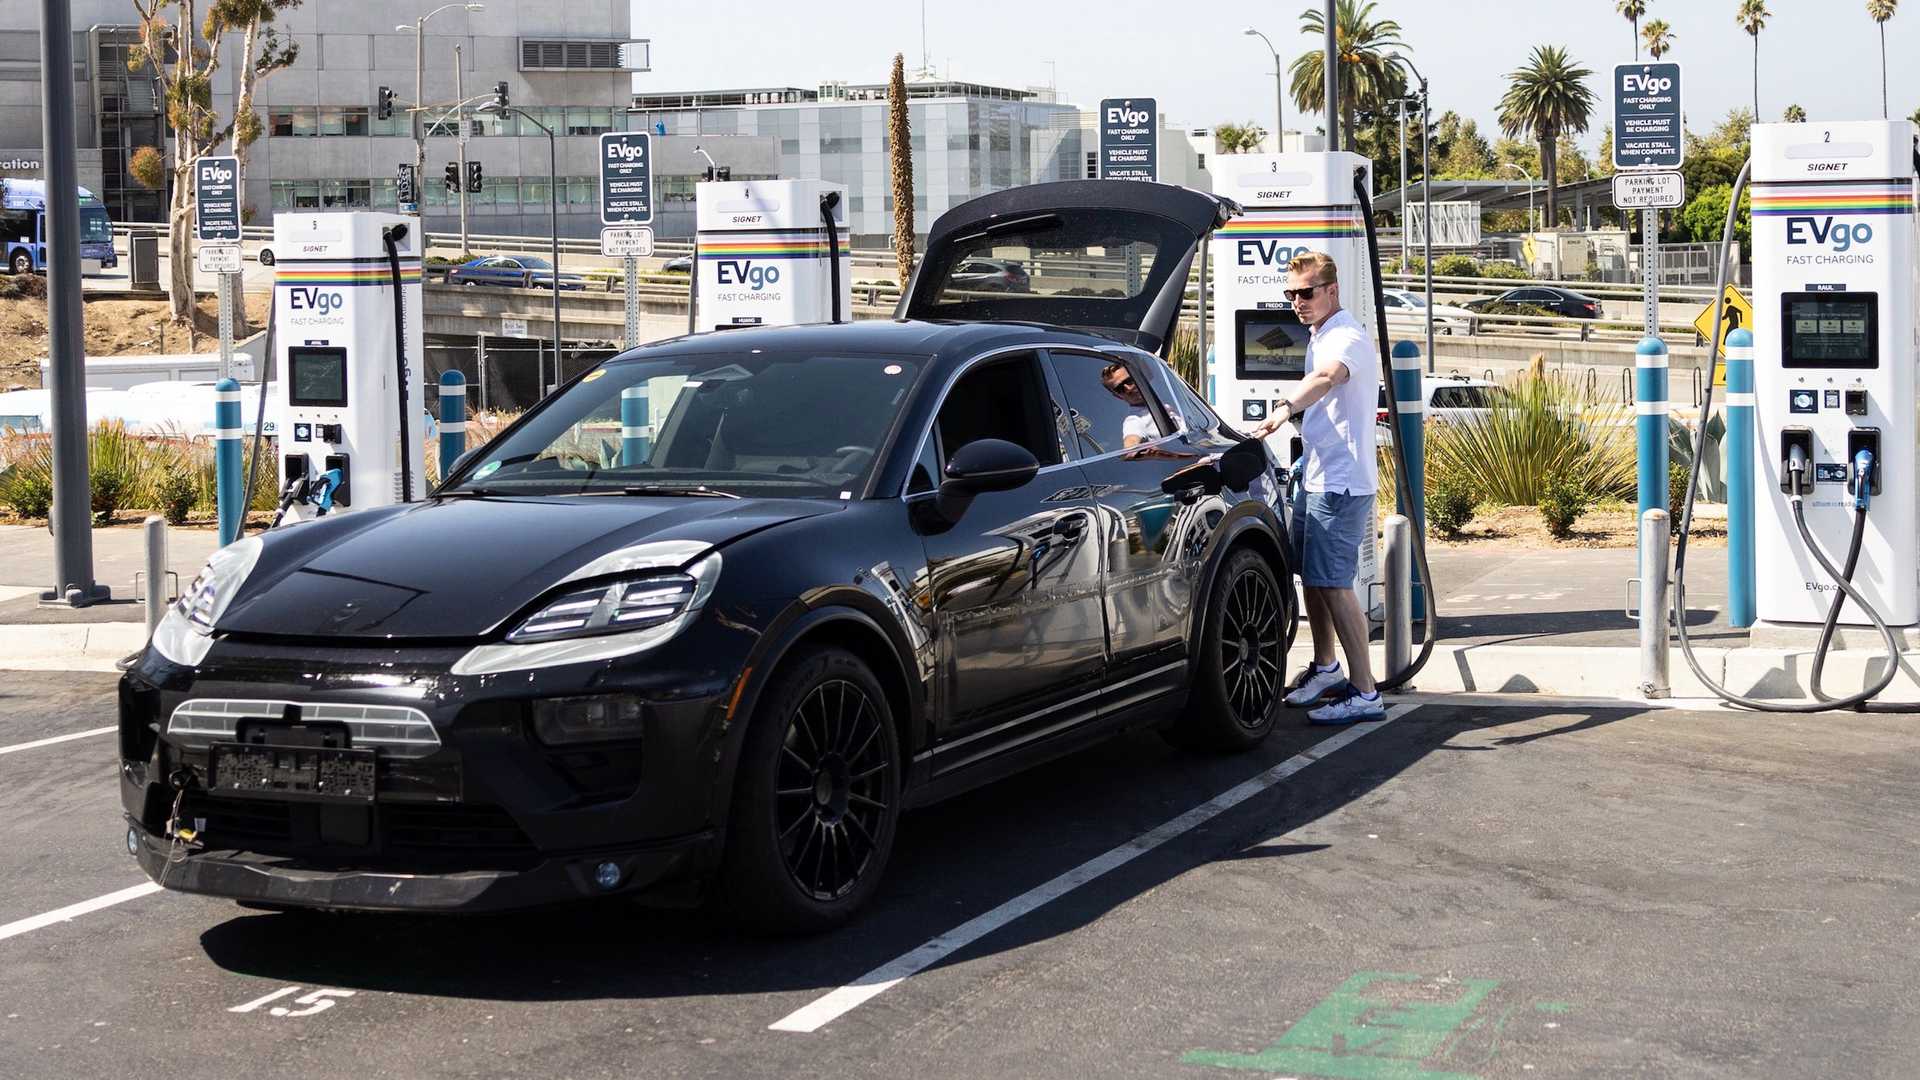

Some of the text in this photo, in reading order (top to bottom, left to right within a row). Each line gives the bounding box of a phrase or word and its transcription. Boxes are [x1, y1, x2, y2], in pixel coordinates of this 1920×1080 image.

[1623, 74, 1672, 95] EVgo
[1107, 108, 1149, 127] EVgo
[1824, 131, 1831, 143] 2
[607, 143, 643, 161] EVgo
[1271, 161, 1277, 173] 3
[1807, 162, 1848, 171] SIGNET
[202, 167, 232, 184] EVgo
[1657, 177, 1671, 185] LOT
[1257, 191, 1292, 199] SIGNET
[1632, 186, 1664, 194] PAYMENT
[1623, 194, 1674, 204] NOT REQUIRED
[732, 215, 762, 223] SIGNET
[1786, 216, 1873, 252] EVgo
[1786, 254, 1874, 264] FAST CHARGING
[717, 260, 780, 290] EVgo
[1237, 276, 1259, 284] FAST
[290, 287, 343, 315] EVgo
[738, 293, 781, 301] CHARGING
[264, 422, 274, 431] 29
[1805, 582, 1838, 593] EVgo.c
[226, 986, 357, 1017] 15
